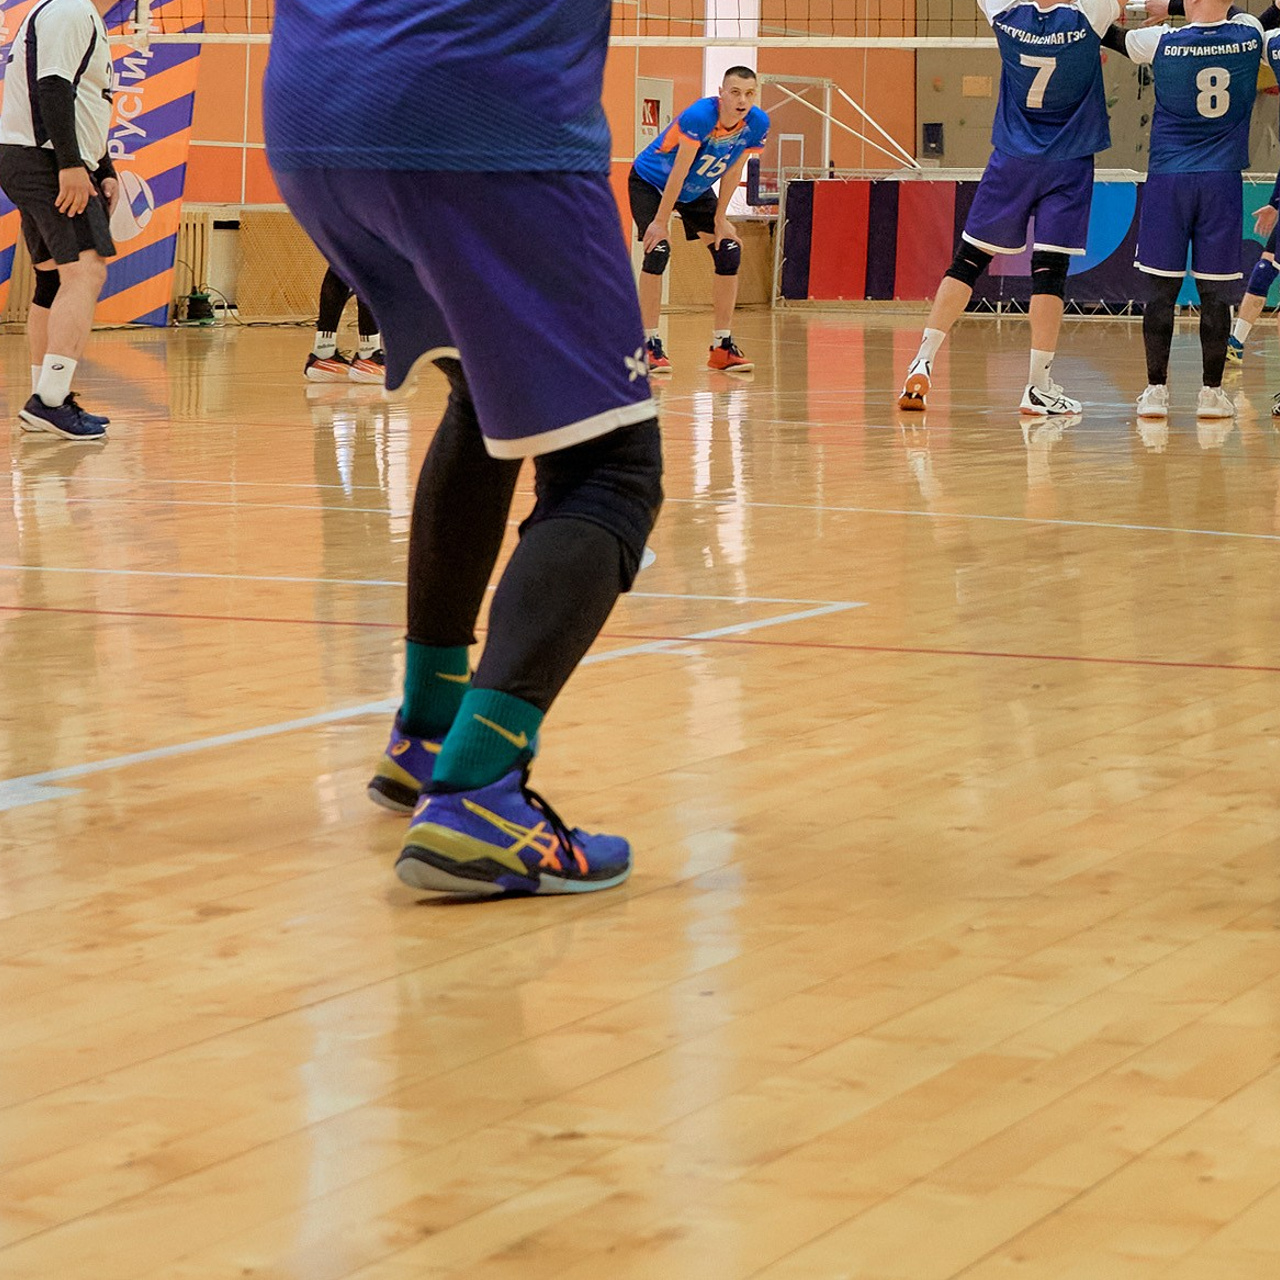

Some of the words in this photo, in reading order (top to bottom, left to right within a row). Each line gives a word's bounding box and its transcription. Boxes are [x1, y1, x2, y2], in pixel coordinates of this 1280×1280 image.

[1067, 28, 1087, 44] ГЭС
[1164, 43, 1240, 57] БОГУЧАНСКАЯ
[1241, 39, 1258, 52] ГЭС
[1020, 53, 1057, 109] 7
[1196, 67, 1231, 118] 8
